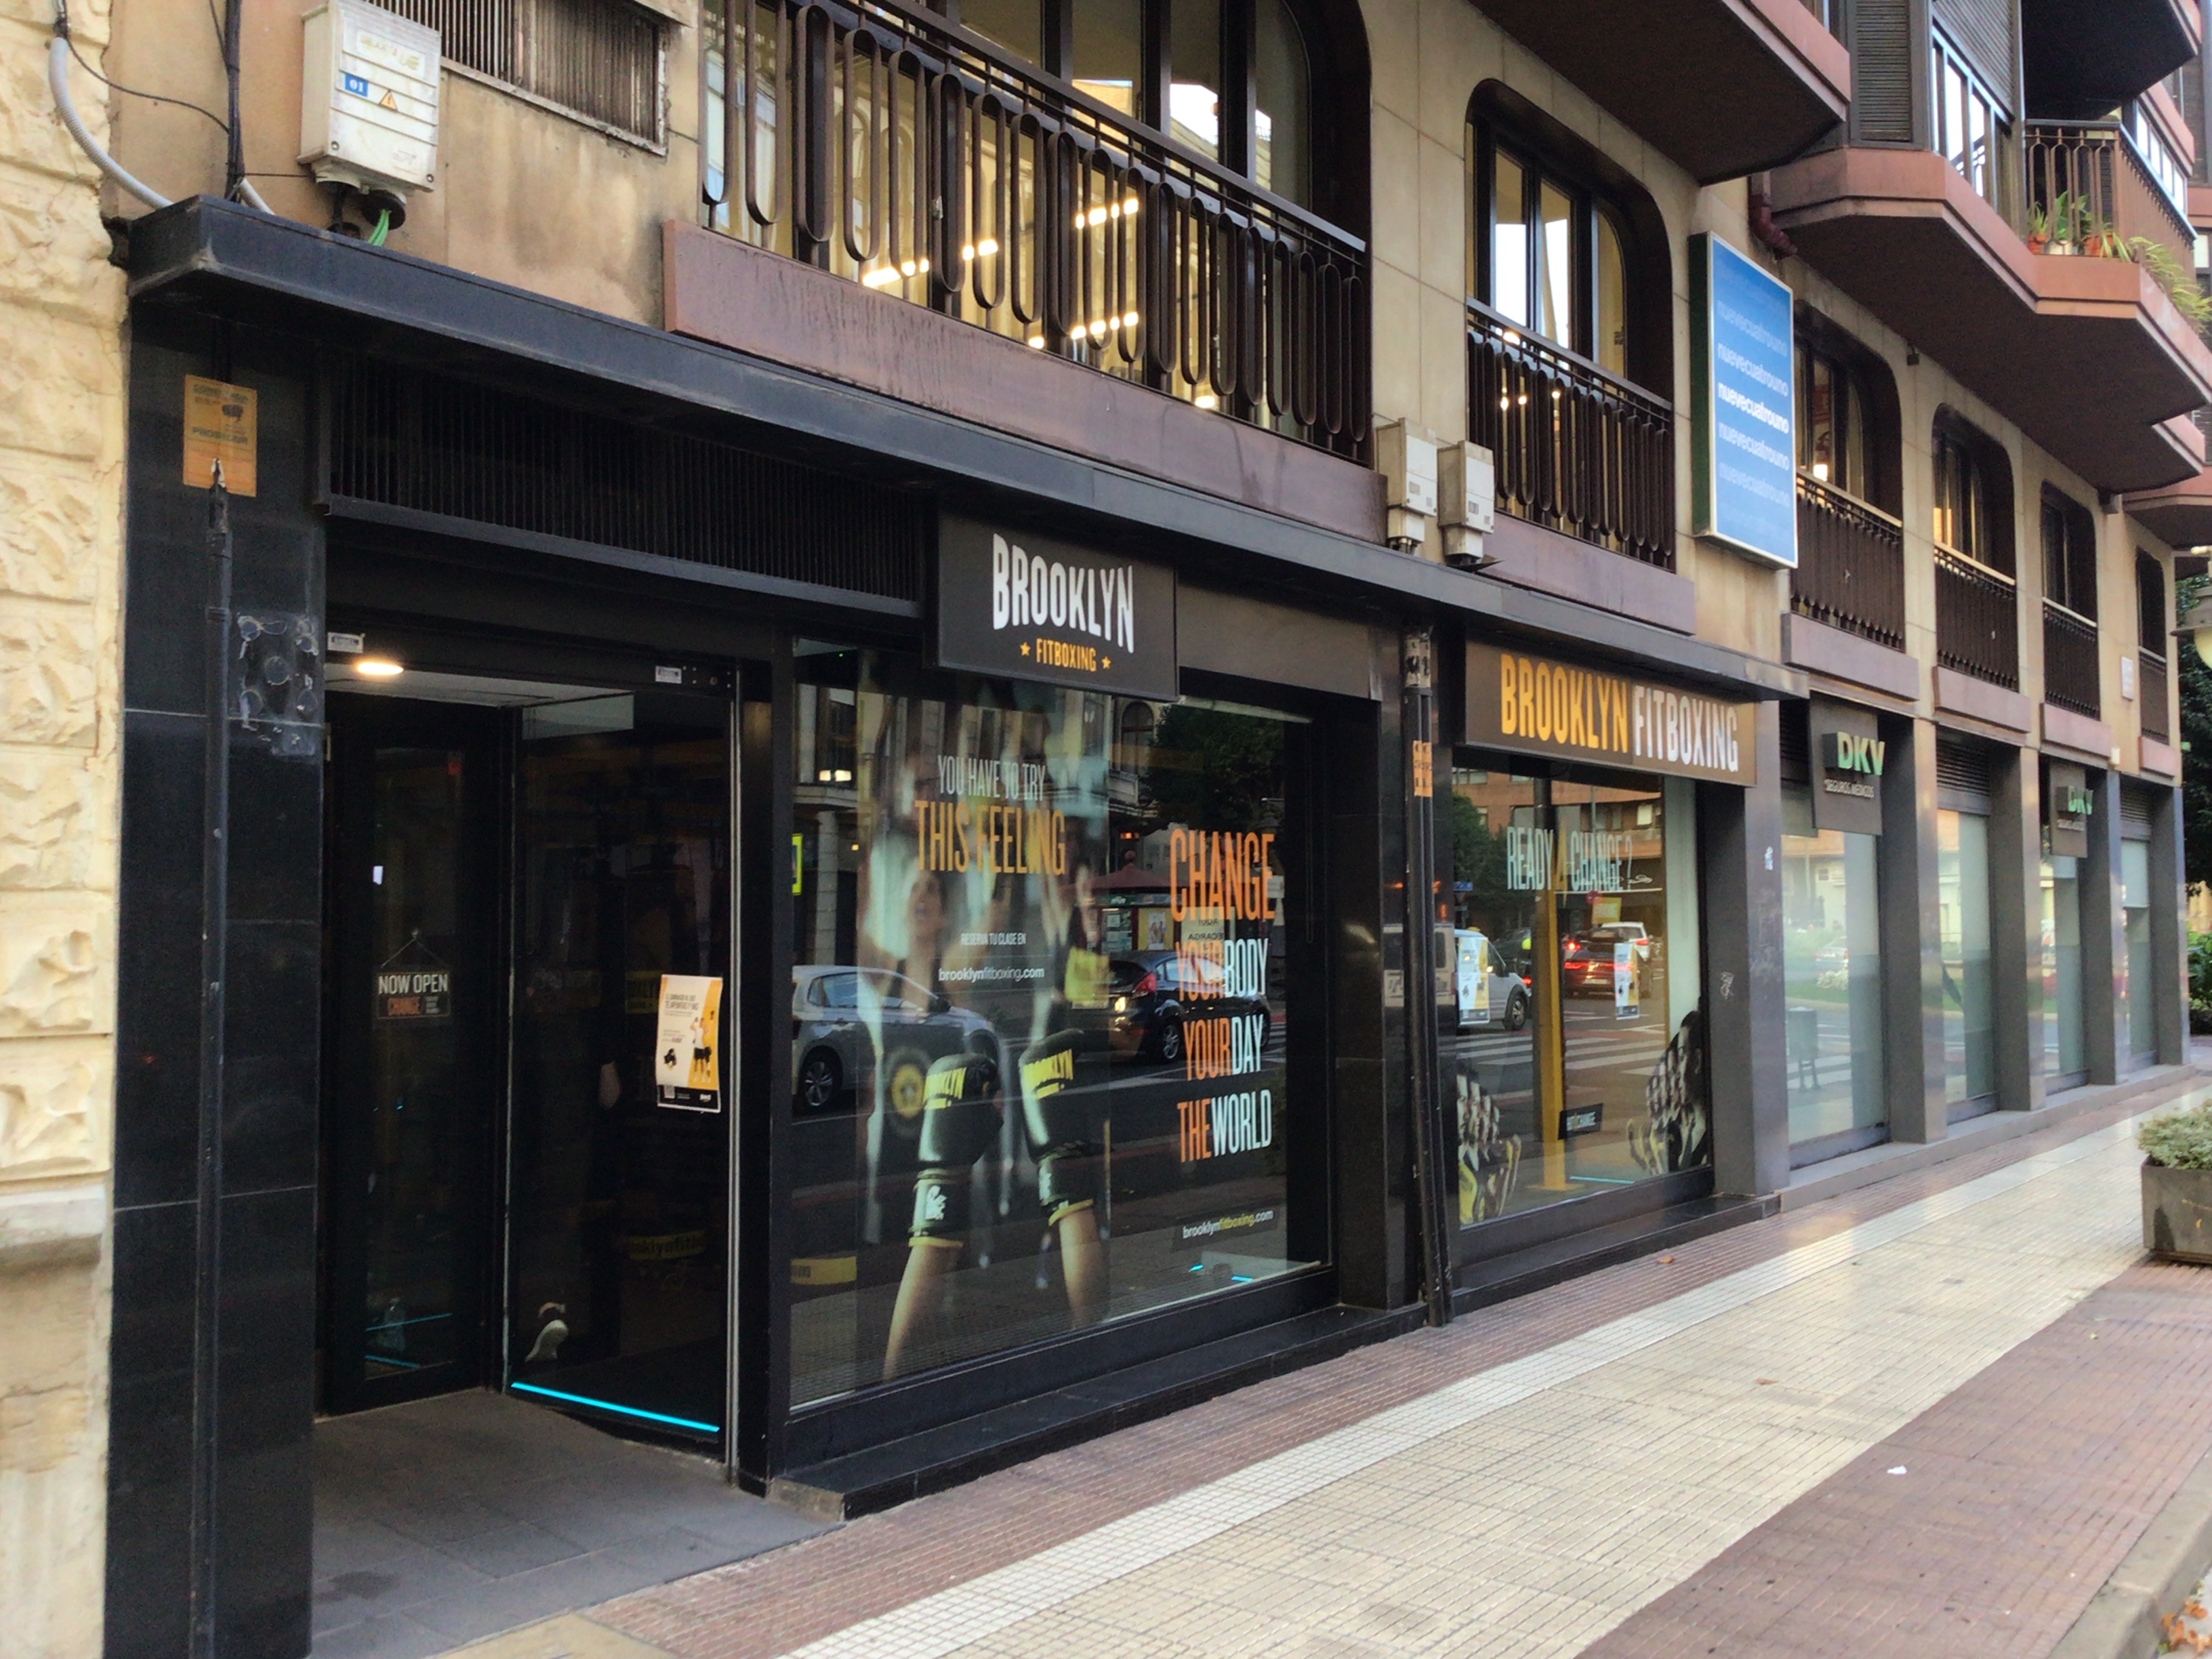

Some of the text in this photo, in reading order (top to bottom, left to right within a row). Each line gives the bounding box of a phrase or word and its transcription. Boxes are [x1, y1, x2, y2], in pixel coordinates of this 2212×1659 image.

[1718, 342, 1788, 397] nuevecuatrouno
[1718, 382, 1790, 434] nuevecuatrouno
[1719, 422, 1790, 471] nuevecuatrouno
[993, 533, 1134, 653] BROOKLYN
[1036, 638, 1097, 672] FITBOXING
[1500, 653, 1629, 754] BROOKLYN
[1633, 684, 1739, 773] FITBOXING
[938, 754, 1046, 801] YOU HAVE TO TRY
[1837, 731, 1885, 776] DKV
[2068, 785, 2094, 815] DKV
[915, 800, 1066, 876] THIS FEELING
[1507, 826, 1554, 890] READY
[1570, 830, 1624, 891] CHANGE
[1170, 829, 1276, 922] CHANGE
[379, 974, 448, 994] NOW OPEN
[939, 966, 1045, 983] brooklynfitboxing.com
[1175, 938, 1269, 1002] YOUR BODY
[1183, 1014, 1264, 1082] YOUR DAY
[1176, 1089, 1272, 1163] THE WORLD
[1183, 1210, 1274, 1239] brooklynfitboxing.com
